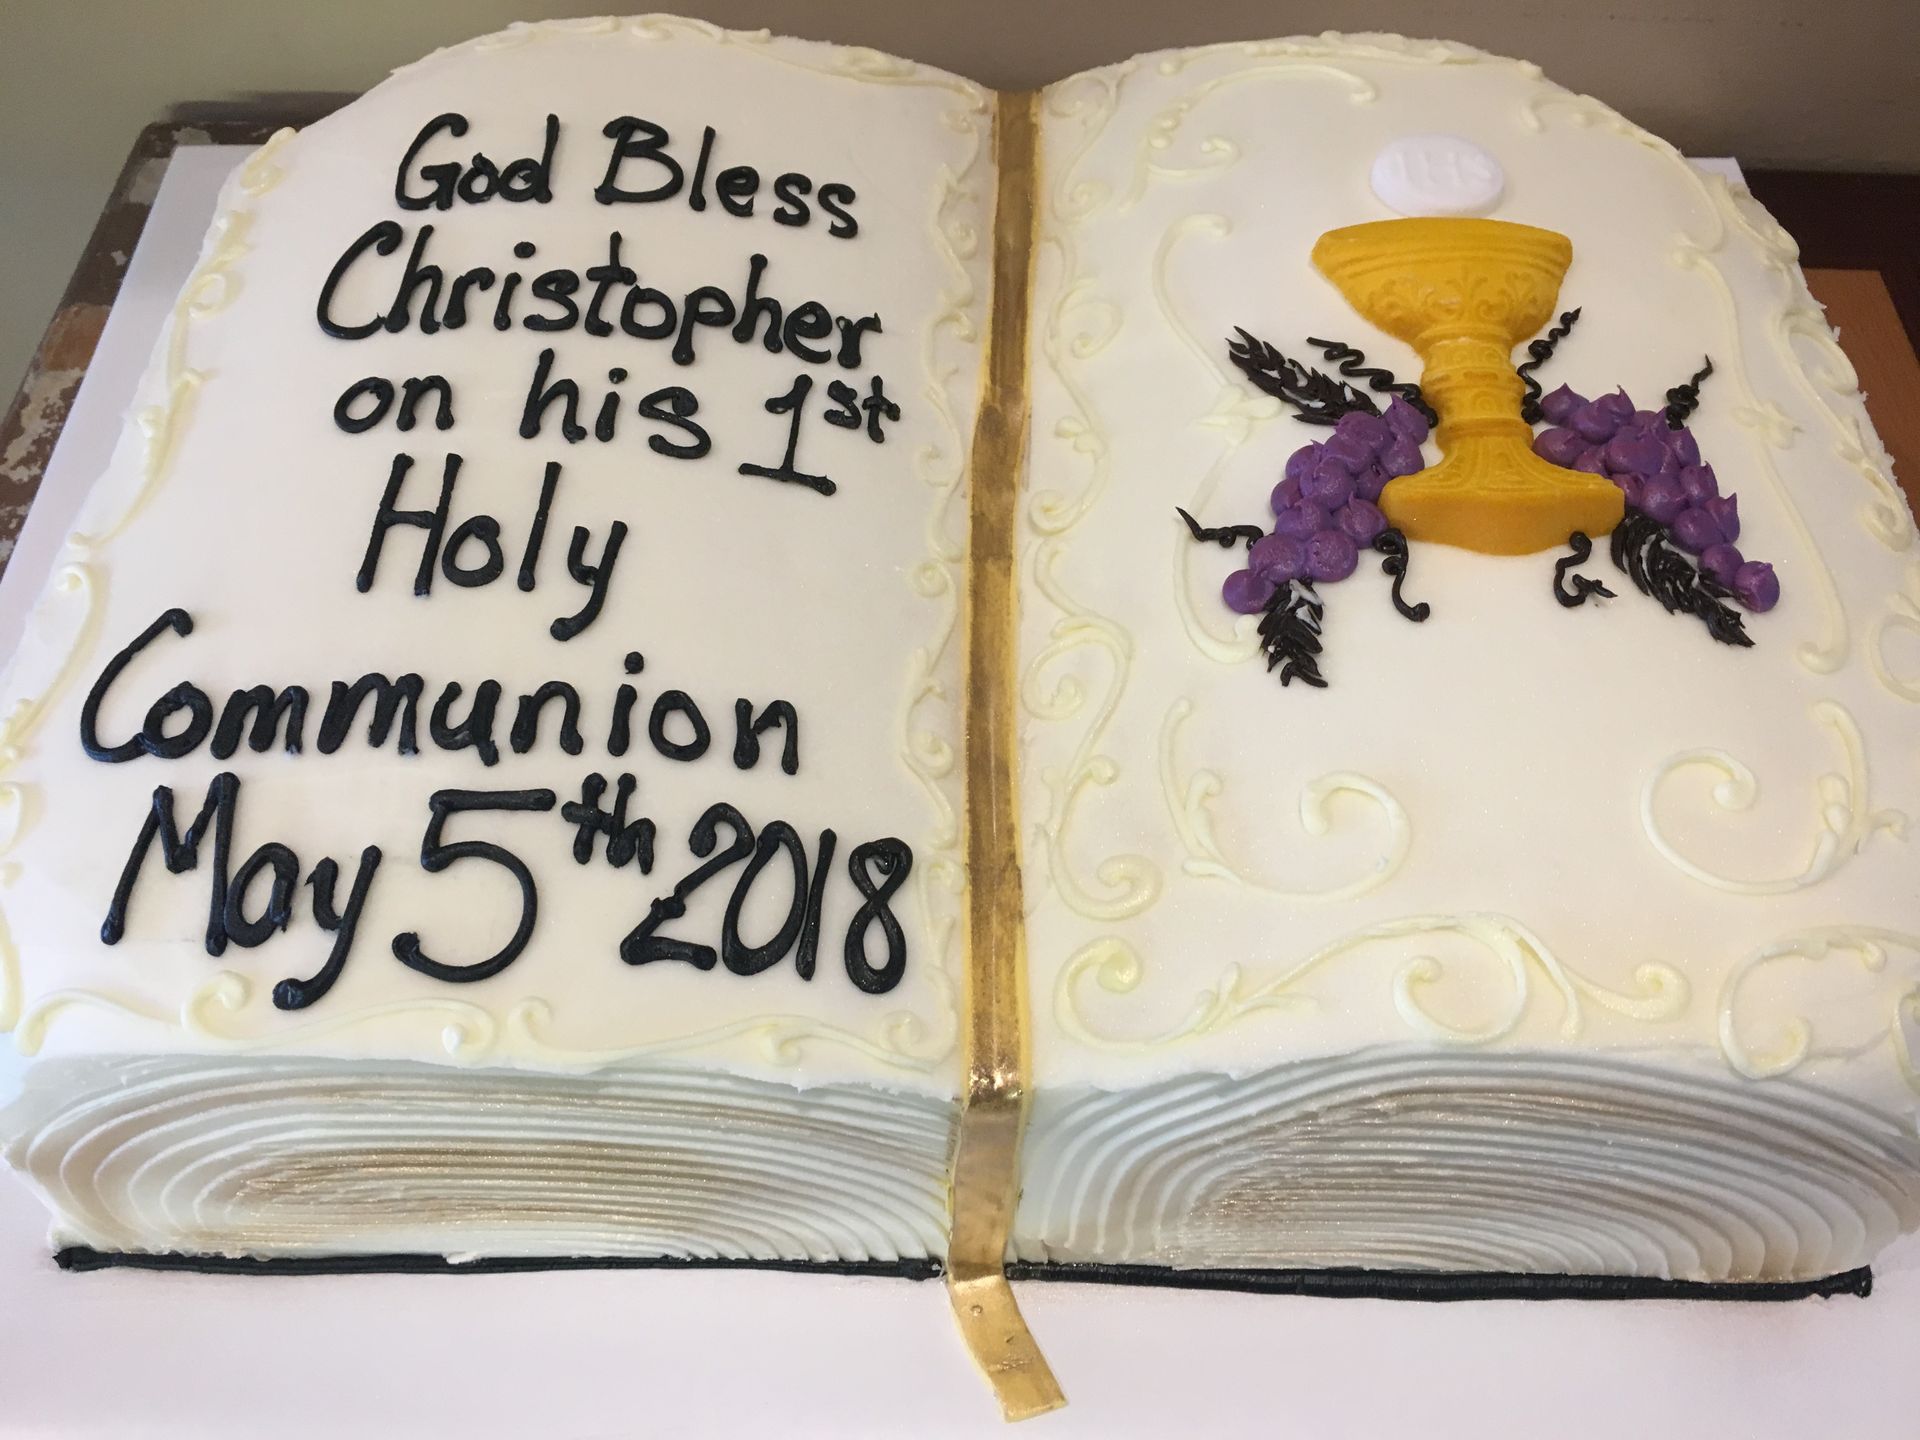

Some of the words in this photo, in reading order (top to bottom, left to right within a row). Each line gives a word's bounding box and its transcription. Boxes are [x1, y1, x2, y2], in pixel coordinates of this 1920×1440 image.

[394, 112, 561, 212] God
[594, 115, 859, 240] Bless
[316, 220, 883, 370] Christopher
[333, 375, 455, 434] on
[519, 347, 712, 460] his
[737, 373, 901, 497] 1st
[356, 452, 629, 642] Holy
[80, 608, 800, 776] Communion
[101, 771, 383, 1011] May
[391, 772, 657, 984] 5th
[619, 802, 914, 995] 2018
